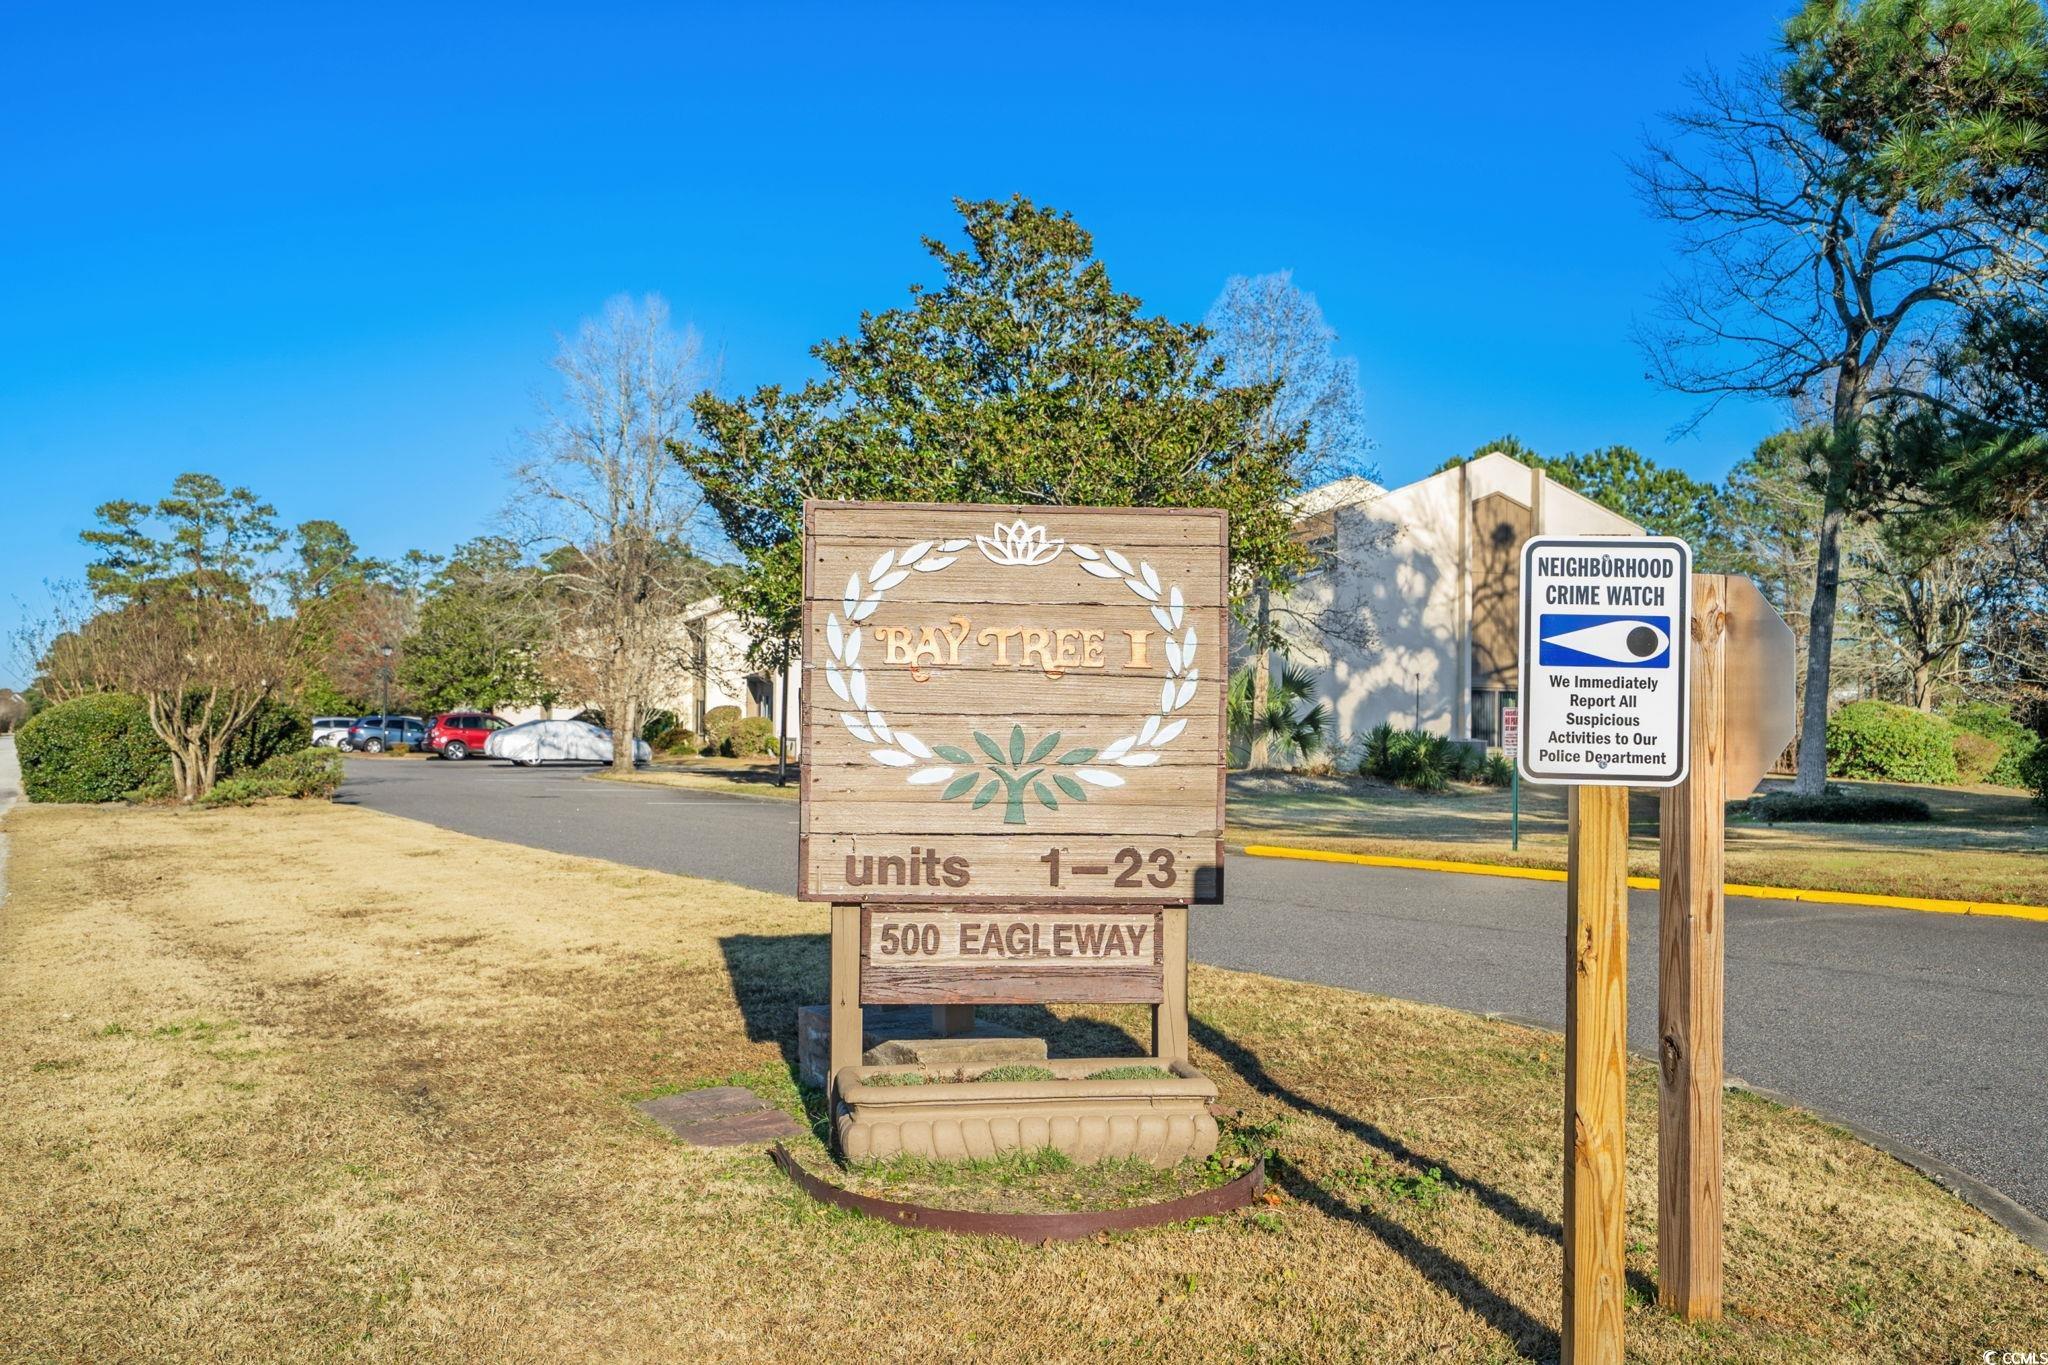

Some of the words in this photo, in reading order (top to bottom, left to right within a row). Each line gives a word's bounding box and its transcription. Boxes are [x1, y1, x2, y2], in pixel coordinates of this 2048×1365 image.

[1538, 557, 1674, 578] NEIGHBORHOOD
[1546, 585, 1600, 605] CRIME
[1607, 586, 1665, 606] WATCH
[874, 616, 971, 682] BAY
[977, 627, 1106, 680] TREE
[1123, 629, 1155, 669] I
[1549, 675, 1570, 688] We
[1575, 675, 1658, 692] Immediately
[1570, 694, 1616, 709] Report
[1619, 695, 1637, 708] All
[1566, 713, 1640, 727] Suspicious
[1548, 731, 1611, 745] Activities
[1615, 732, 1629, 745] to
[1633, 733, 1657, 746] Our
[1539, 749, 1581, 763] Police
[1585, 750, 1667, 765] Department
[845, 846, 971, 888] units
[880, 923, 940, 955] 500
[959, 923, 1148, 957] EAGLEWAY
